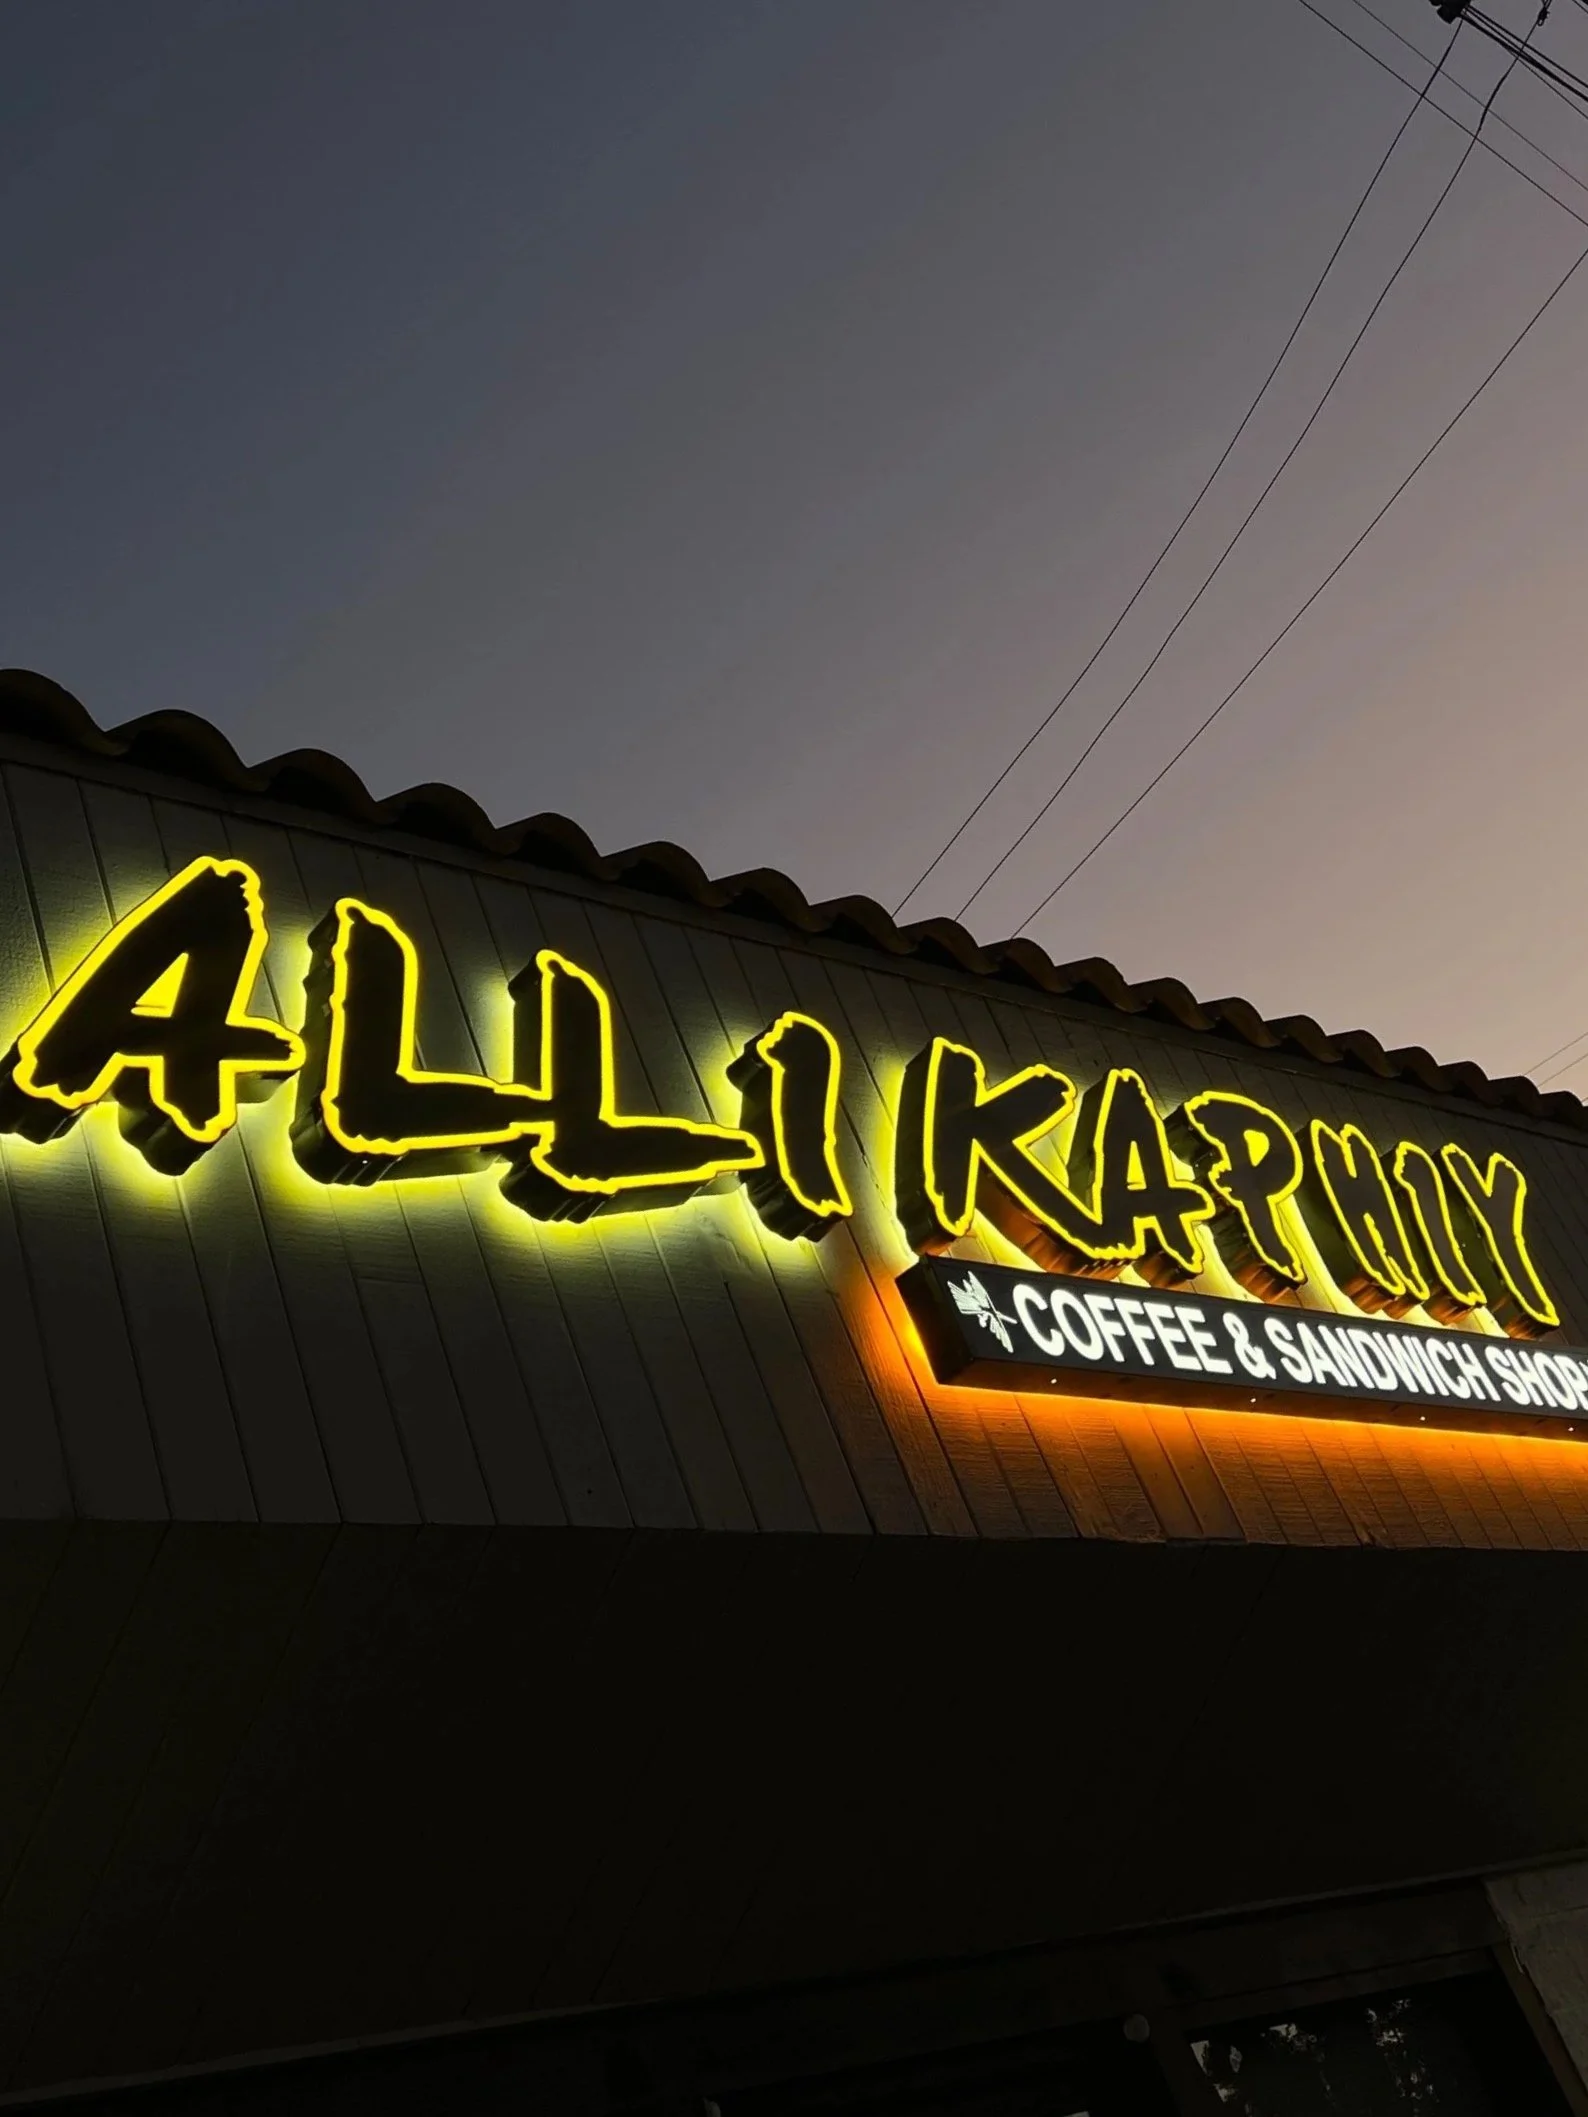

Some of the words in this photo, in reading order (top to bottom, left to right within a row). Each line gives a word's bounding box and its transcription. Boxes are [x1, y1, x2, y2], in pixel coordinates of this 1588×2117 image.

[923, 1036, 1560, 1328] KAPHIY
[1012, 1283, 1233, 1374] COFFEE
[1222, 1311, 1277, 1380] &
[1263, 1317, 1501, 1402] SANDWICH
[1484, 1345, 1588, 1411] SHOP
